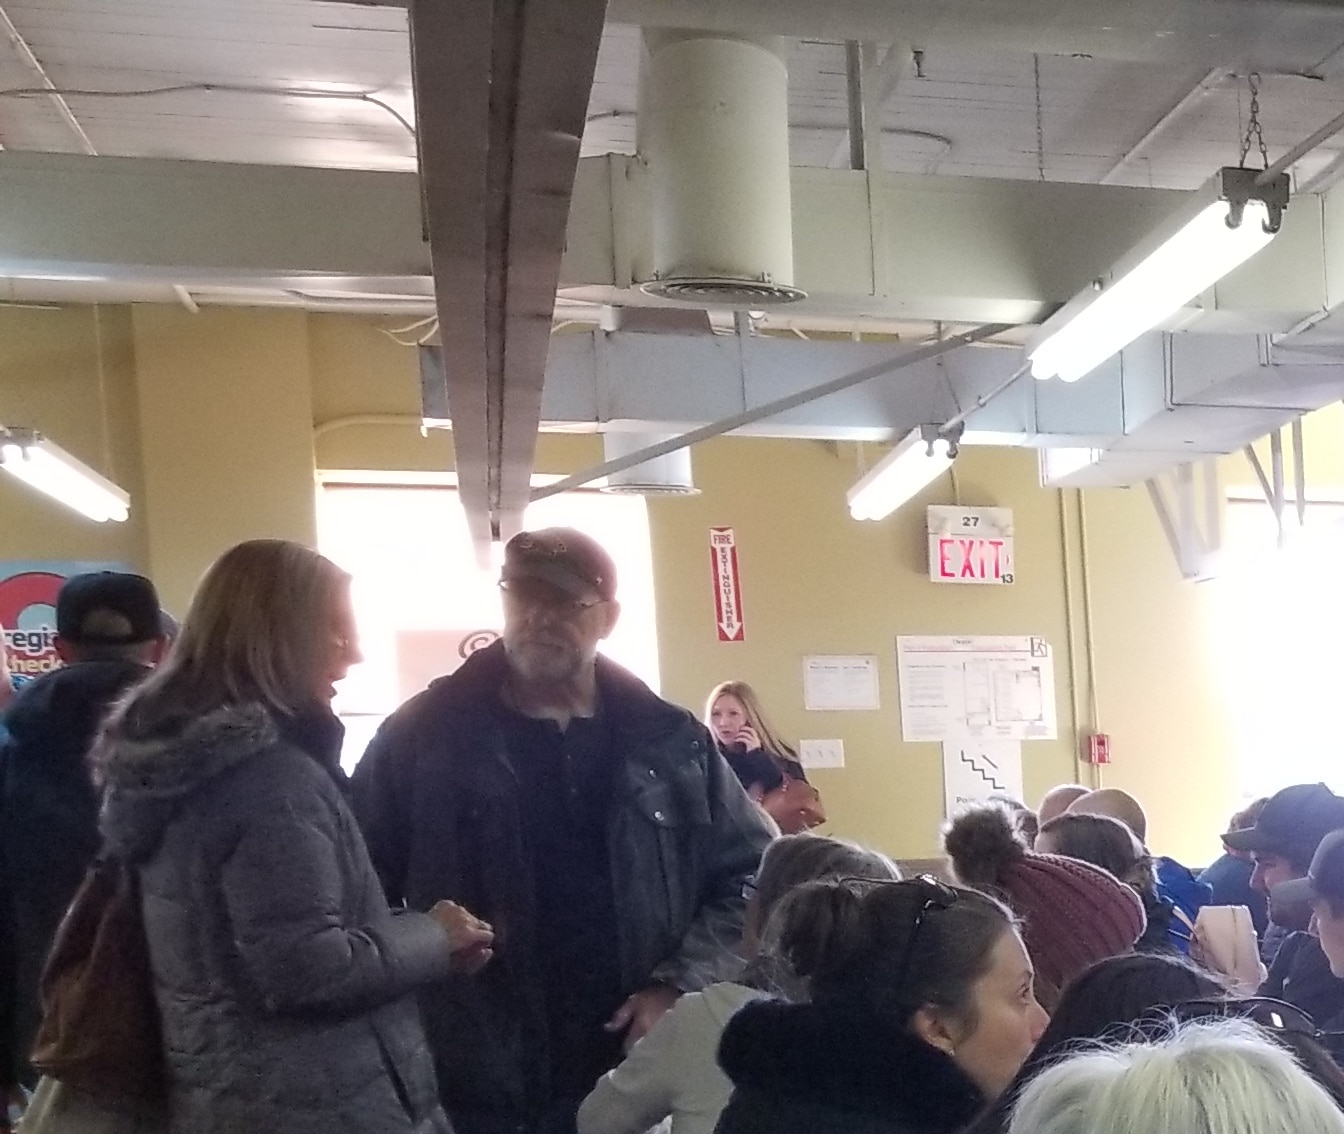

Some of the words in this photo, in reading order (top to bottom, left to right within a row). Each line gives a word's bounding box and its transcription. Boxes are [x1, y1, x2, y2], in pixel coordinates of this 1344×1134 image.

[962, 516, 979, 526] 27
[713, 534, 731, 545] FIRE
[939, 539, 1003, 578] EXIT
[1000, 573, 1014, 583] 13
[720, 547, 735, 629] EXTINGUISHER
